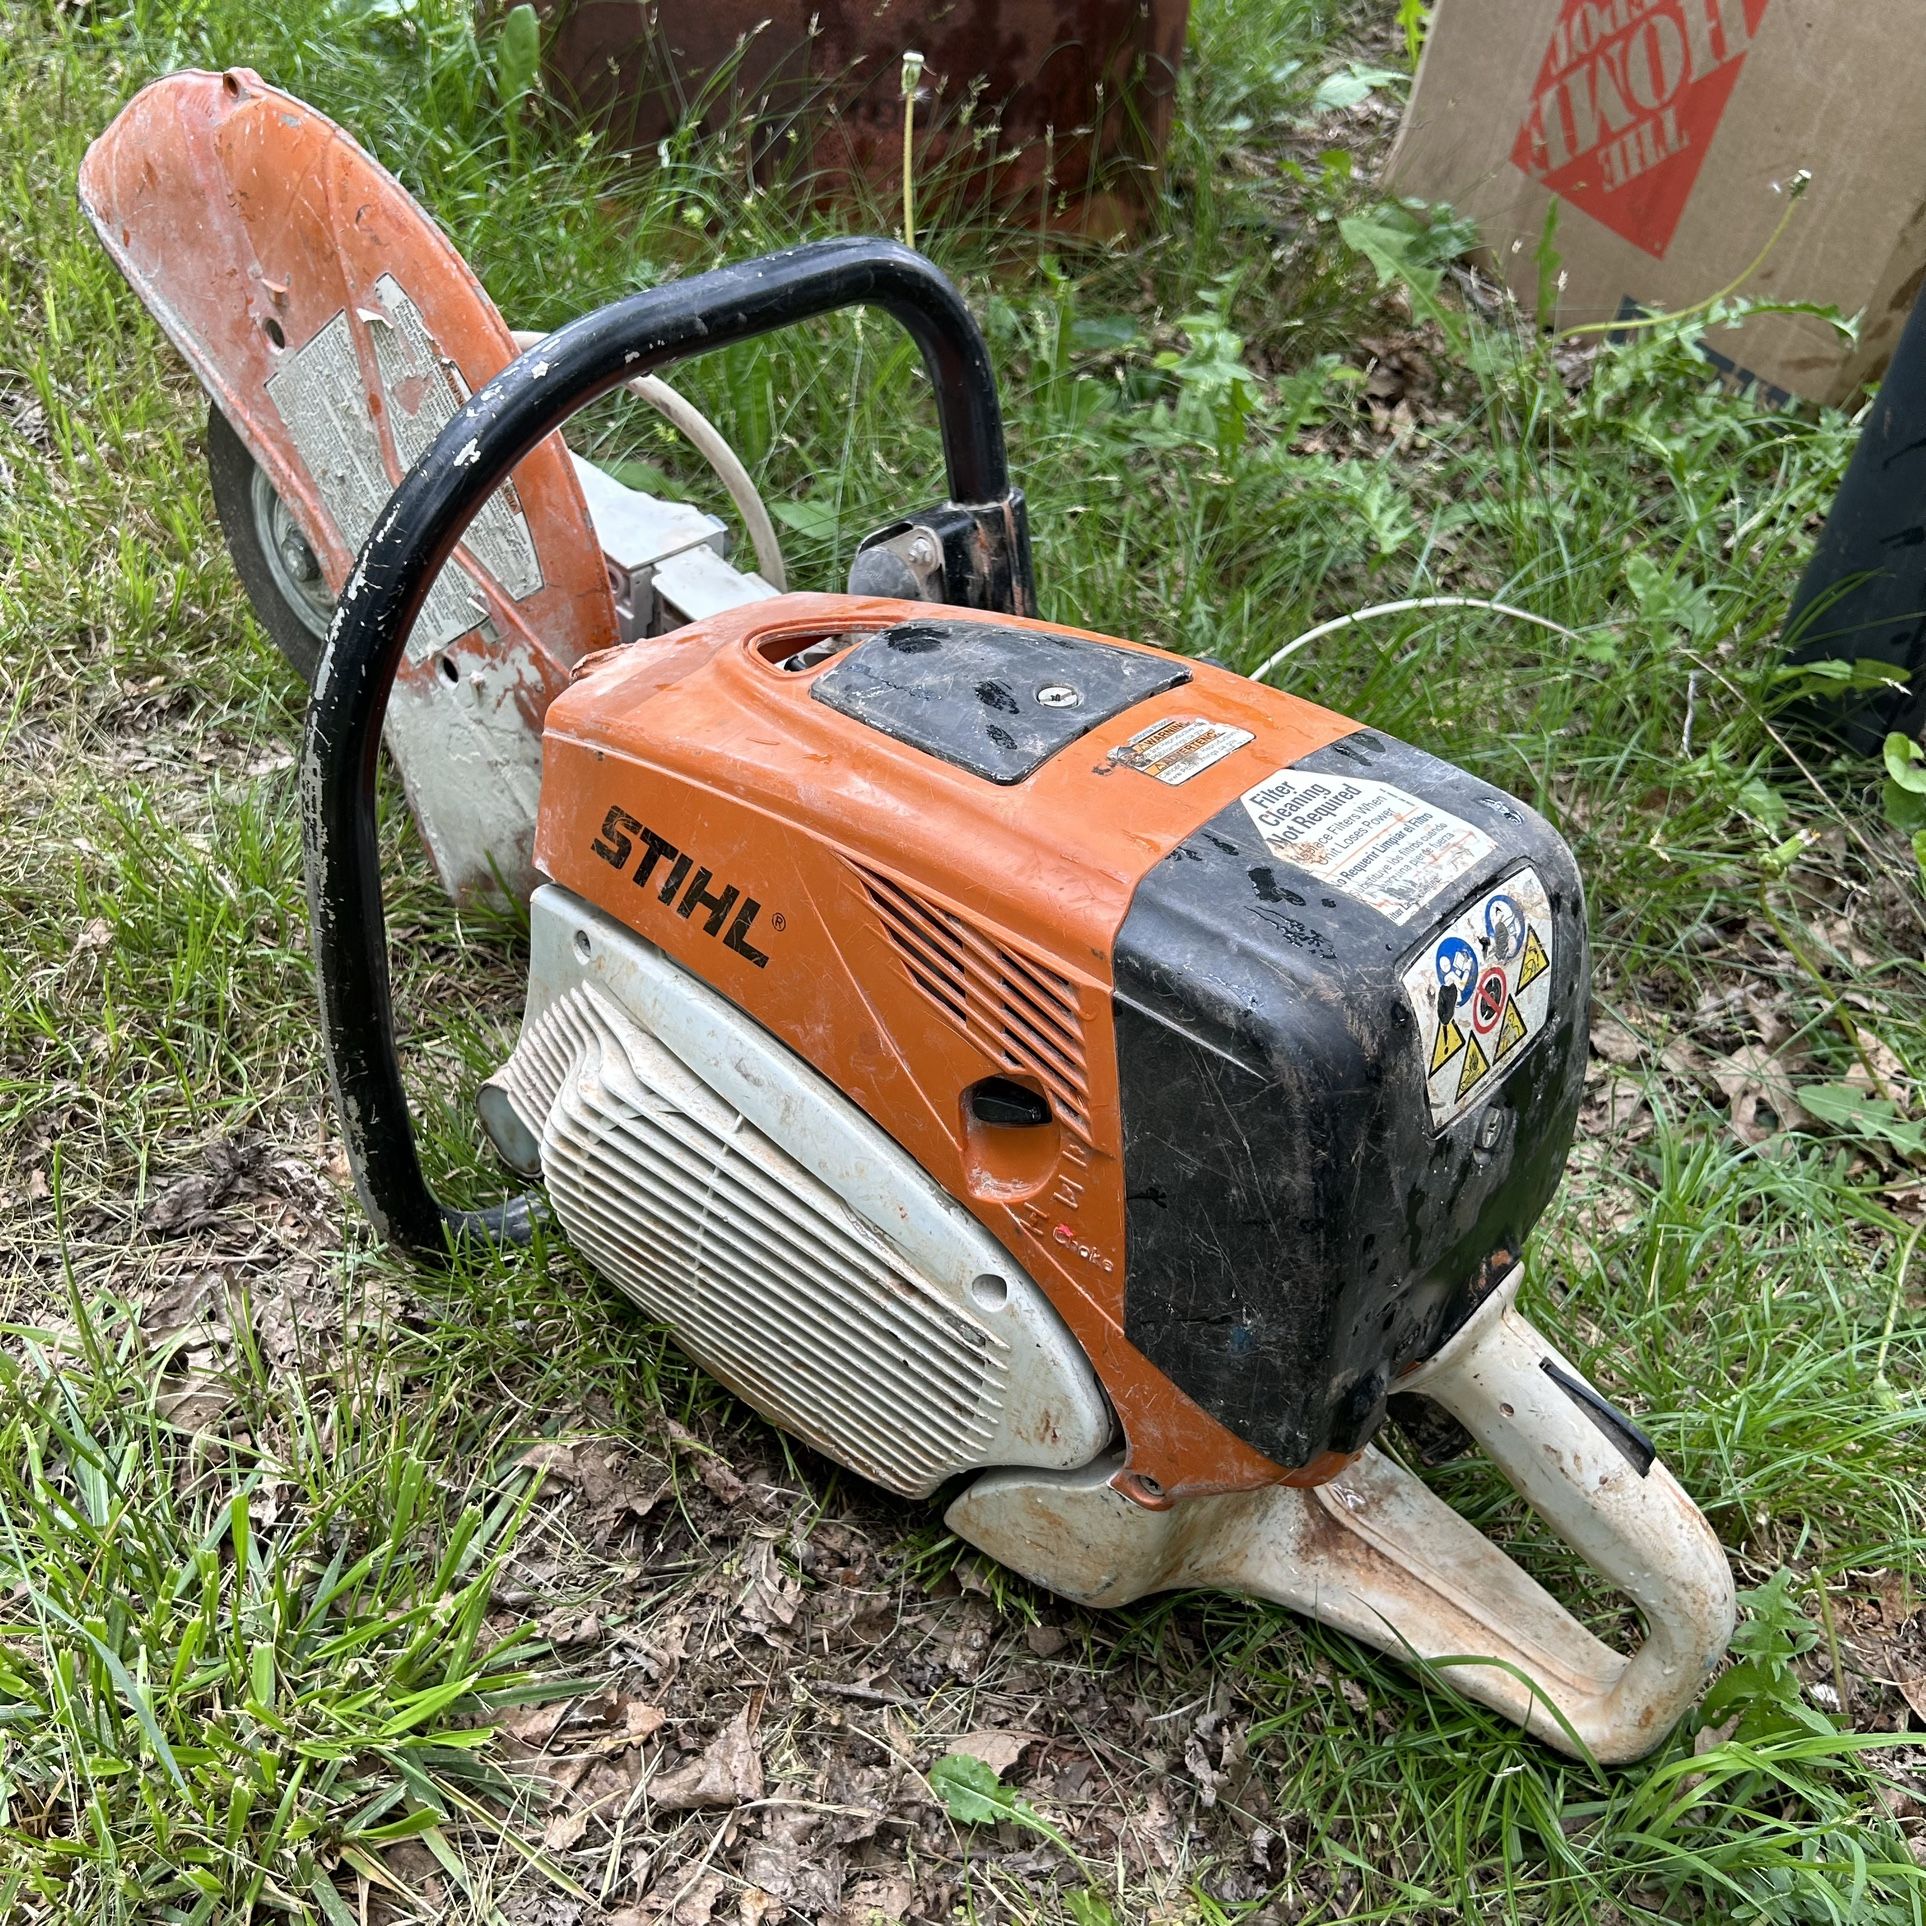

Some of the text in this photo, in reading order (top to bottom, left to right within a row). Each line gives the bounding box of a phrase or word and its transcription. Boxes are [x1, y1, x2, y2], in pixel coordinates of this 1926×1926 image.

[1525, 0, 1757, 178] HOME
[1600, 107, 1692, 193] THE
[1147, 721, 1189, 748] WARNIN
[1249, 782, 1295, 808] Filter
[1259, 784, 1331, 826] Cleaning
[1327, 814, 1361, 834] Filters
[1355, 796, 1387, 814] When
[1267, 826, 1304, 849] Not
[1292, 784, 1361, 829] Required
[1312, 808, 1393, 865] Unit Loses Power
[1404, 824, 1413, 832] el
[1408, 814, 1432, 827] Filtro
[1373, 831, 1406, 853] Limpiar
[590, 805, 769, 969] STIHL
